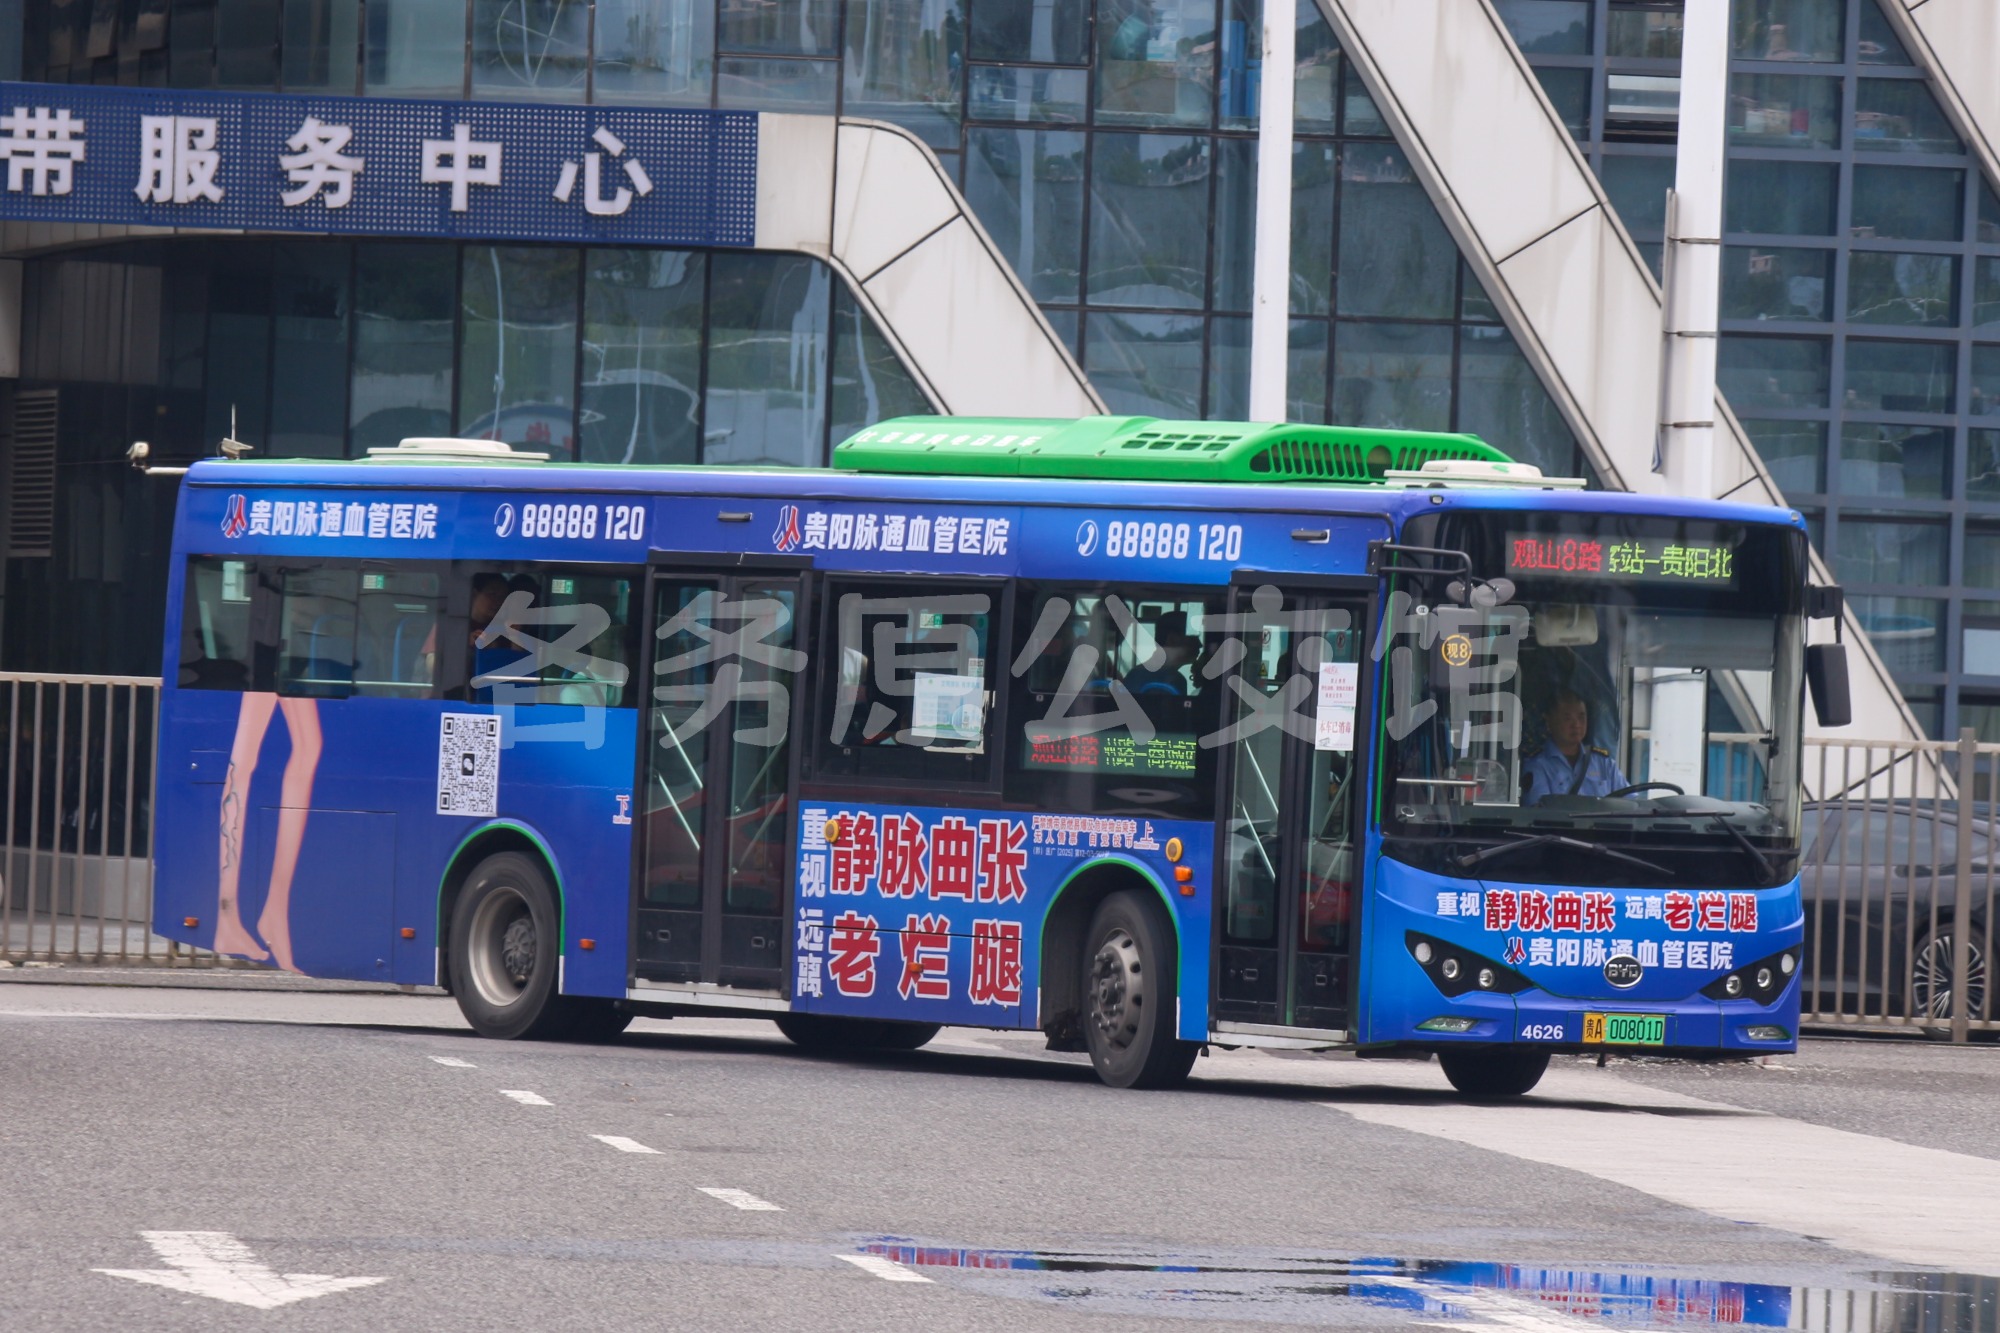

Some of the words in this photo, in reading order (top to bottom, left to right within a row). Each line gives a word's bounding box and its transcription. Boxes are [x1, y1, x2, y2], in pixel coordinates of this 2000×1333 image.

[0, 107, 653, 216] 带服务中心
[249, 500, 438, 539] 贵阳脉通血管医院
[521, 503, 597, 539] 88888
[604, 505, 645, 541] 120
[802, 510, 1010, 556] 贵阳脉通血管医院
[1106, 521, 1189, 560] 88888
[1197, 523, 1243, 562] 120
[1511, 538, 1602, 573] 观山8路
[1446, 643, 1468, 659] 观8
[799, 808, 828, 898] 重视
[829, 811, 1028, 904] 静脉曲张
[1436, 891, 1481, 917] 重视
[1483, 889, 1616, 932] 静脉曲张
[1625, 895, 1662, 919] 远离
[1662, 890, 1758, 932] 老烂腿
[797, 906, 824, 997] 远离
[828, 910, 1023, 1006] 老烂腿
[1529, 937, 1734, 971] 贵阳脉通血管医院
[1608, 963, 1639, 978] BYD
[1521, 1024, 1564, 1040] 4626
